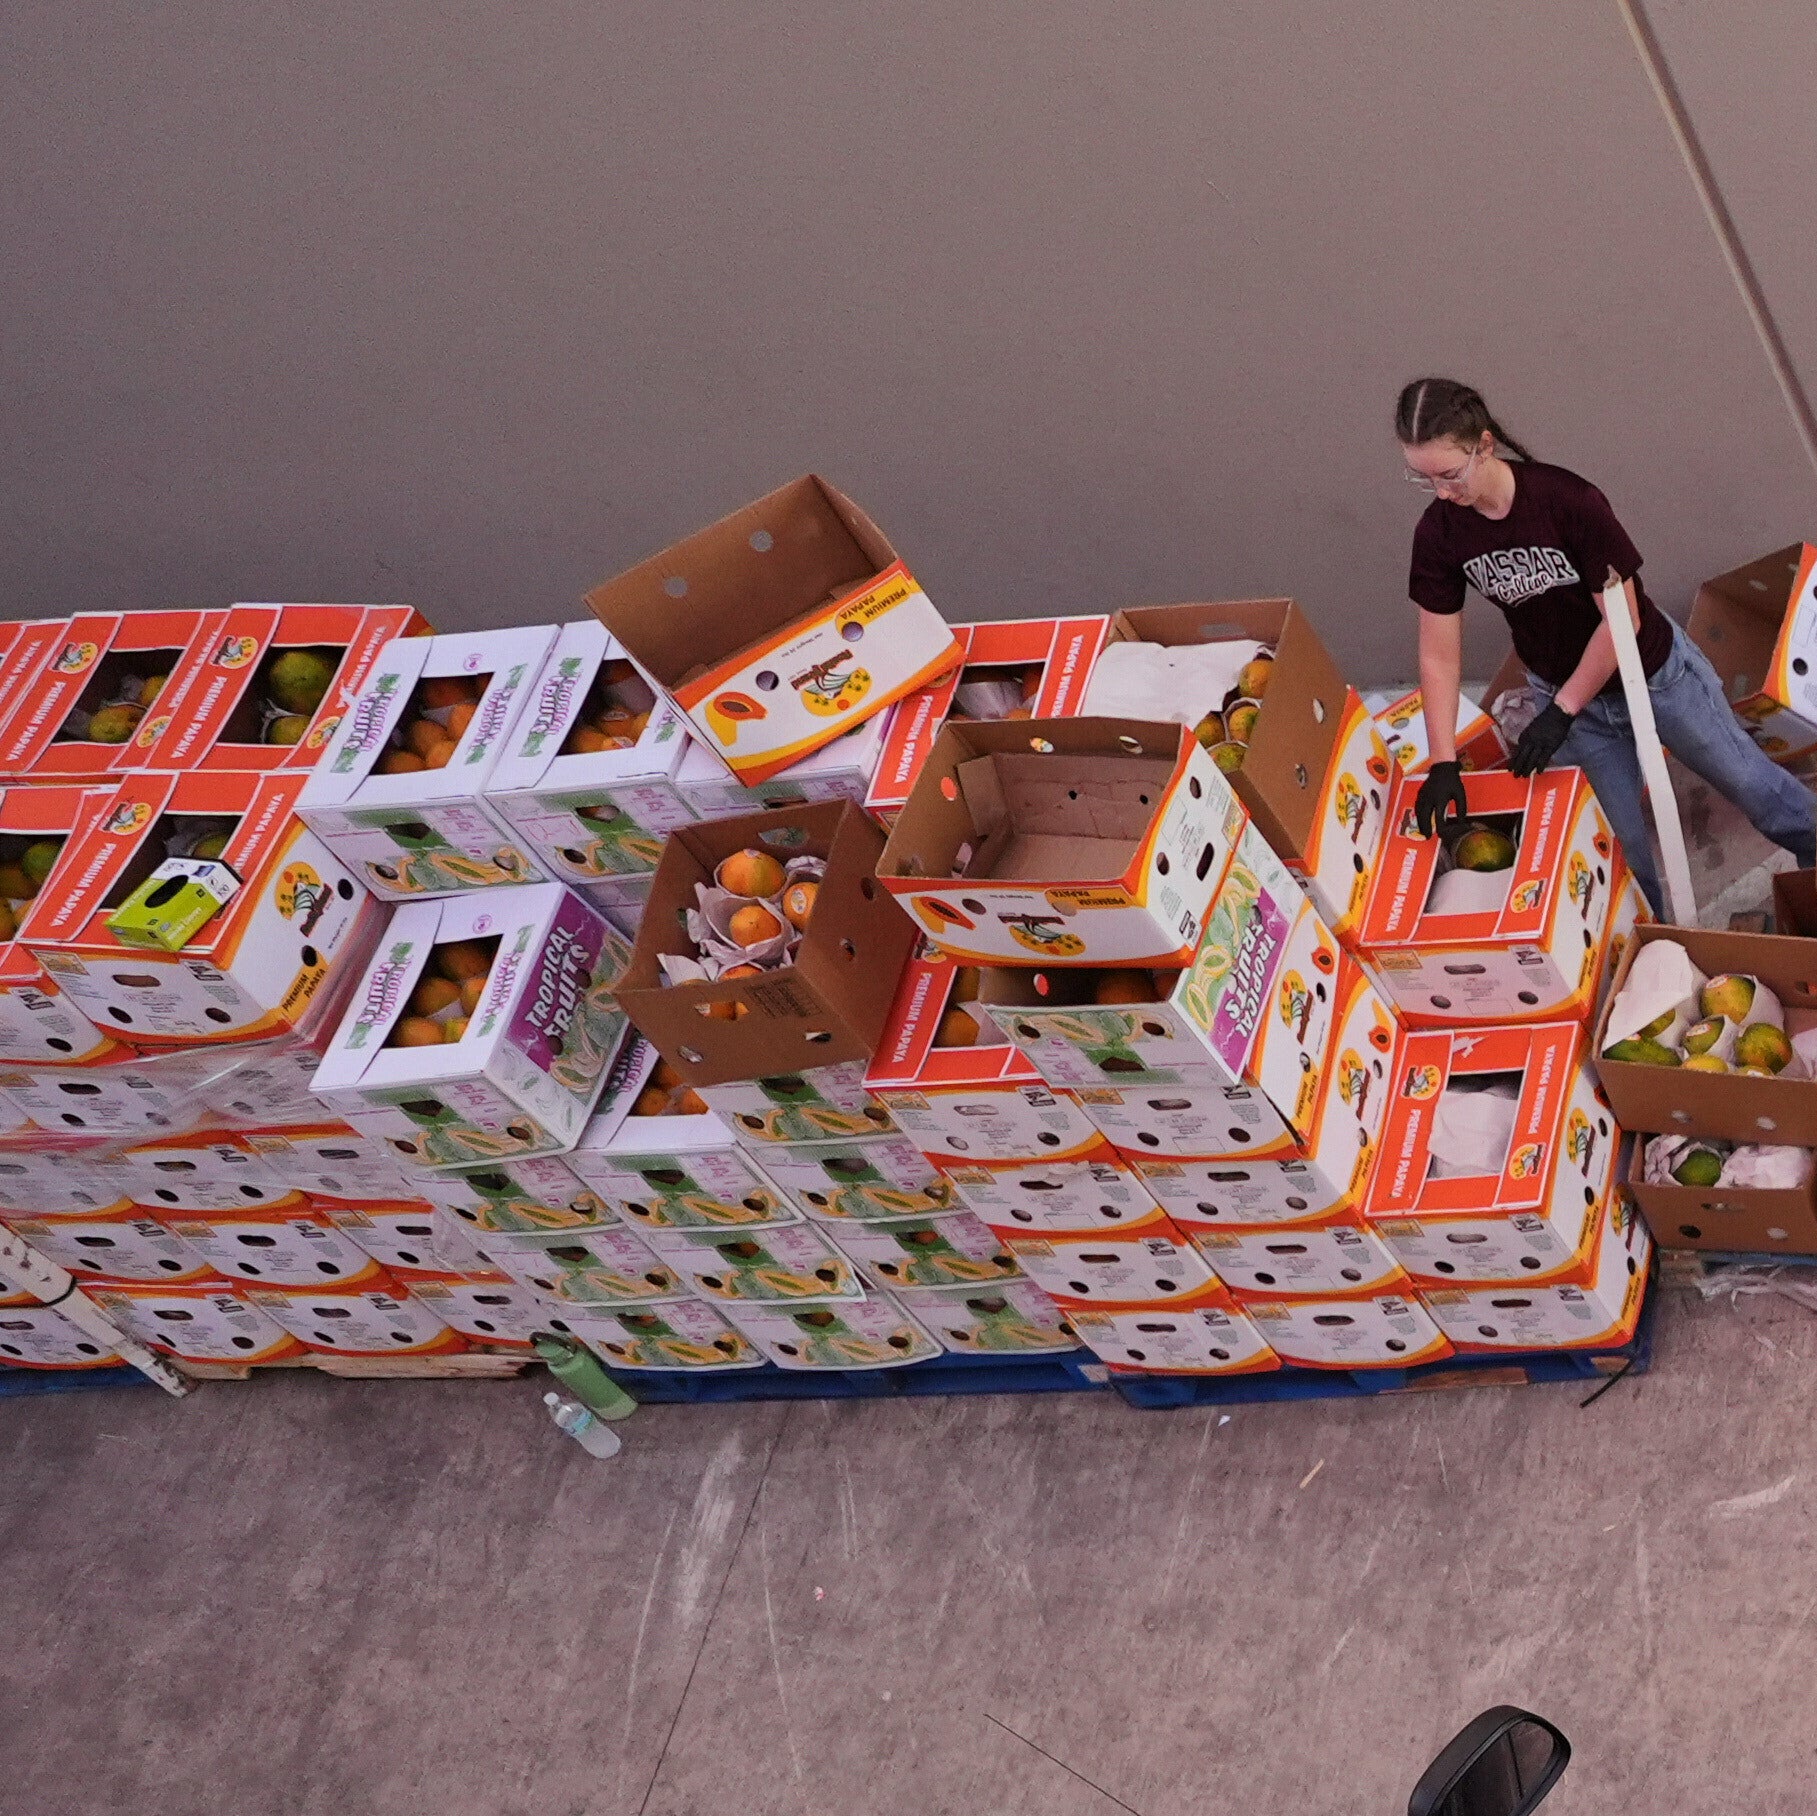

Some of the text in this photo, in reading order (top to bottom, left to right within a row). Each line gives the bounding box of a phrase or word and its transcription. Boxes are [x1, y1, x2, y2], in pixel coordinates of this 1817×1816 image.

[839, 594, 876, 620] PAPAYA
[864, 588, 908, 619] PREMIUM
[1463, 546, 1580, 597] VASSAR
[1496, 572, 1552, 604] College
[359, 626, 388, 670] PAPAYA
[1063, 634, 1084, 675] PAPAYA
[6, 681, 66, 762] PREMIUM PAPAYA
[171, 675, 228, 759] PREMIUM PAPAYA
[895, 695, 934, 783] PREMIUM PAPAYA
[255, 792, 285, 834] PAPAYA
[1529, 787, 1557, 874] PREMIUM PAPAYA
[50, 843, 117, 927] PREMIUM PAPAYA
[1385, 848, 1418, 933] PREMIUM PAPAYA
[282, 973, 309, 1011] PREMIUM
[303, 967, 326, 999] PAPAYA
[525, 926, 576, 1027] TROPICAL
[544, 943, 591, 1039] FRUITS
[1224, 919, 1265, 1020] FRUITS
[1234, 932, 1277, 1039] TROPICAL
[891, 971, 933, 1064] PREMIUM PAPAYA
[1527, 1044, 1557, 1135] PREMIUM PAPAYA
[1404, 1108, 1422, 1156] PREMIUM
